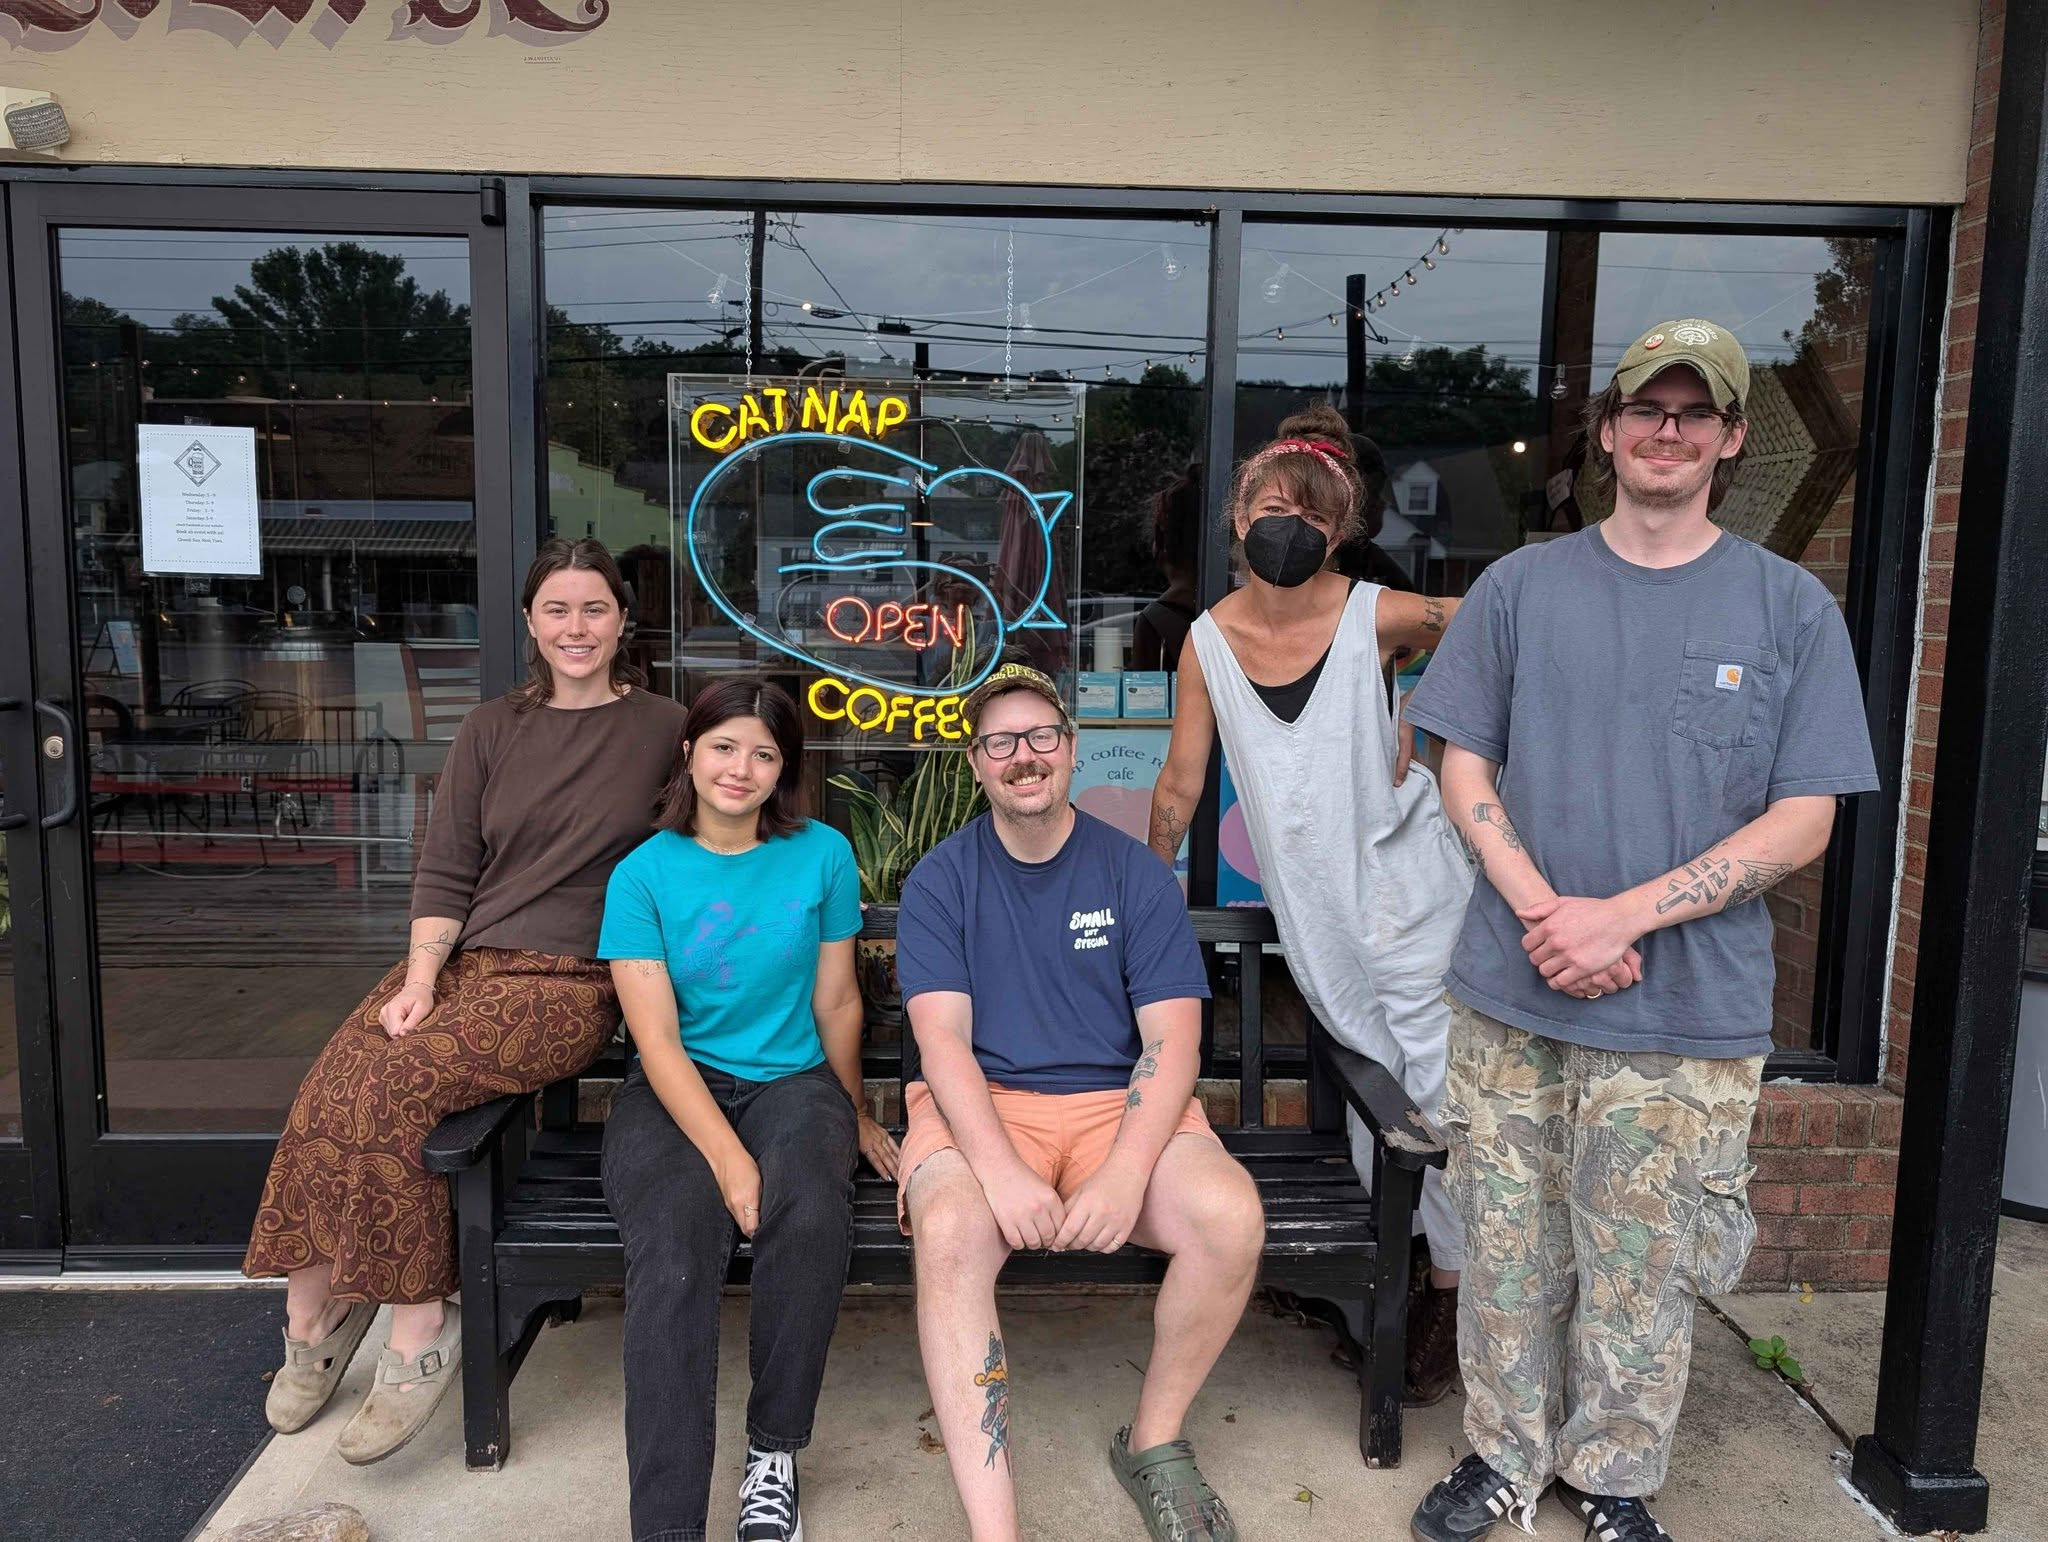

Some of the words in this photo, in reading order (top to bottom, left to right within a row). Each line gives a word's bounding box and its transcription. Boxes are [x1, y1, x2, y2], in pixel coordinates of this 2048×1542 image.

[691, 388, 787, 449] CAT
[801, 387, 907, 436] NAP
[827, 597, 964, 647] OPEN
[1091, 745, 1146, 762] coffee
[1107, 766, 1134, 781] cafe
[1069, 908, 1115, 930] SMALL
[1084, 928, 1099, 938] BUT
[1074, 935, 1109, 950] SPECIAL
